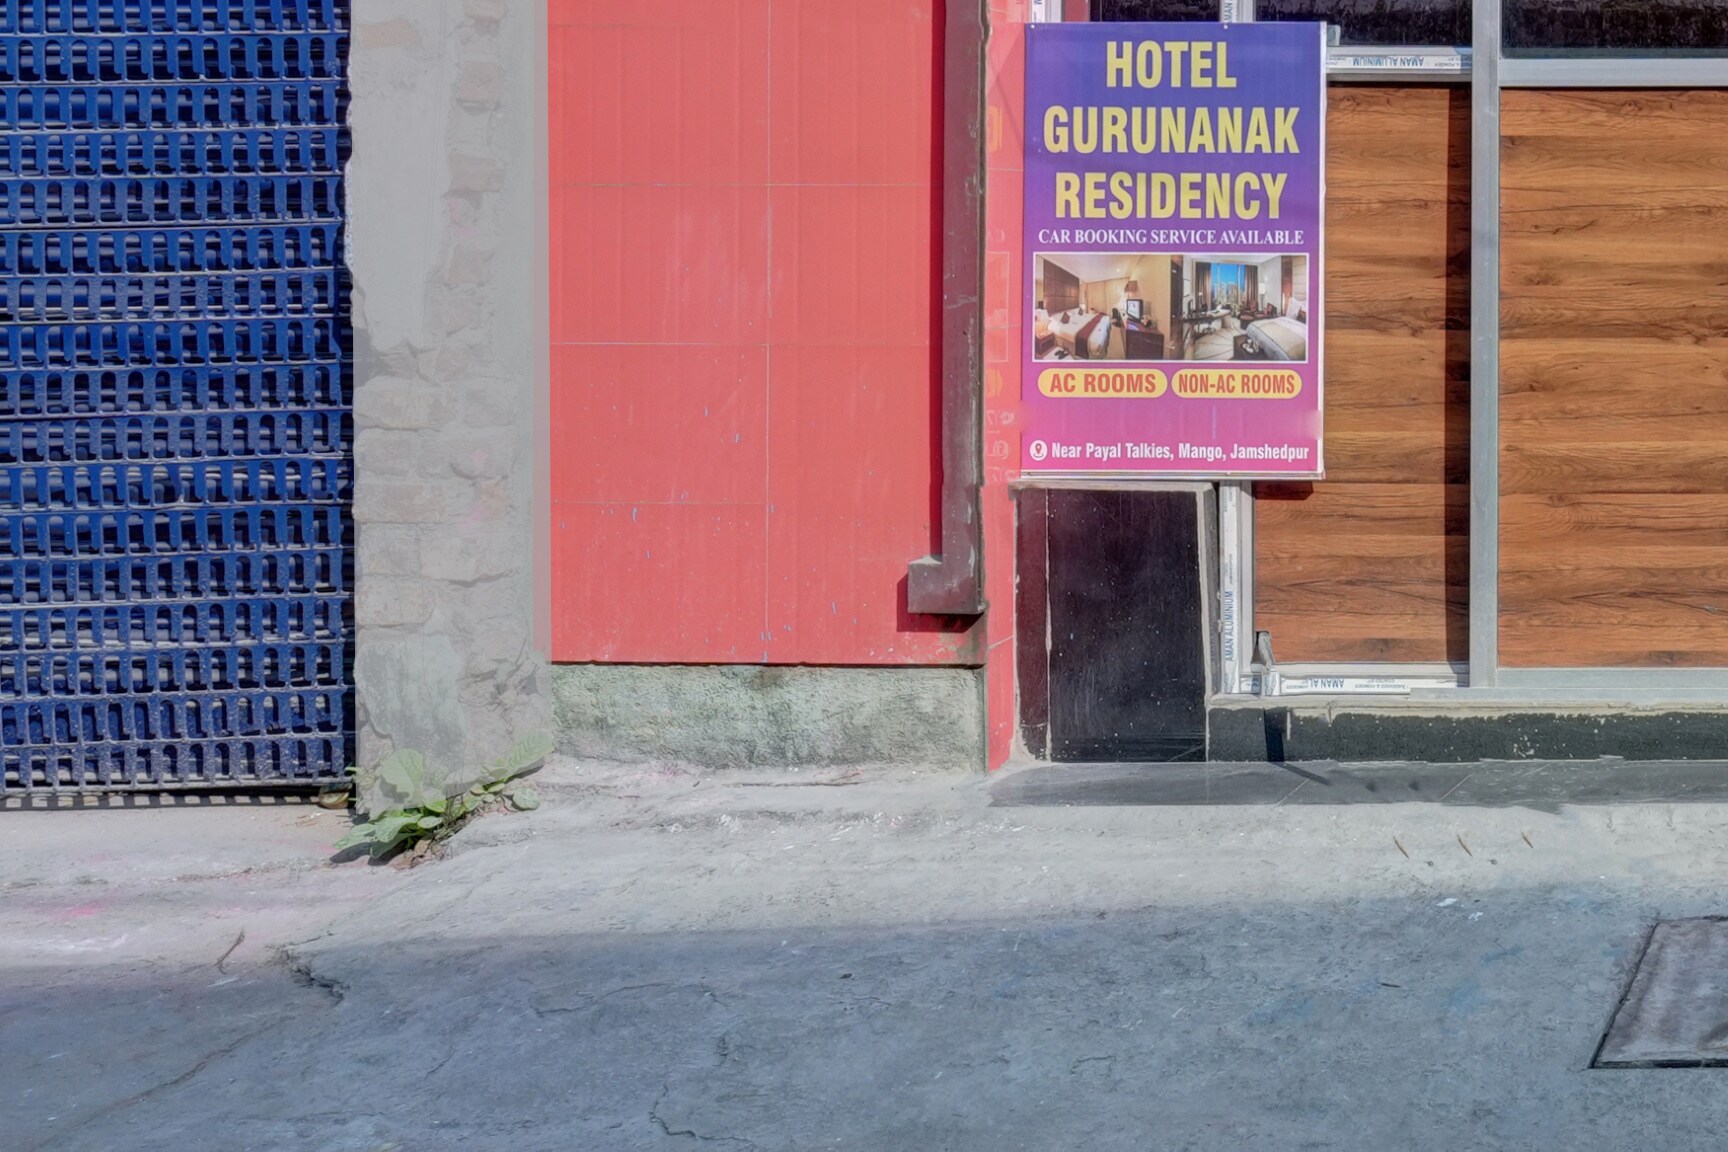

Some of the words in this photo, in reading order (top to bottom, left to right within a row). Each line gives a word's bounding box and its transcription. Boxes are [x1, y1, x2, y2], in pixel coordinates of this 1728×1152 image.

[1106, 40, 1237, 88] HOTEL
[1352, 56, 1398, 66] ALUMINIUM
[1400, 56, 1424, 66] AMAN
[1043, 105, 1300, 154] GURUNANAK
[1055, 171, 1288, 219] RESIDENCY
[1038, 229, 1072, 244] CAR
[1074, 229, 1148, 245] BOOKING
[1150, 230, 1217, 244] SERVICE
[1220, 230, 1305, 246] AVAILABLE
[1049, 373, 1077, 393] AC
[1086, 373, 1157, 394] ROOMS
[1177, 373, 1237, 394] NON-AC
[1241, 373, 1295, 395] ROOMS
[1051, 442, 1083, 458] Near
[1086, 442, 1121, 462] Payal
[1125, 442, 1175, 460] Talkies,
[1178, 443, 1227, 463] Mango,
[1230, 443, 1310, 463] Jamshedpur
[1225, 591, 1233, 636] ALUMINIUM
[1225, 638, 1234, 662] AMAN
[1320, 678, 1344, 688] AMAN
